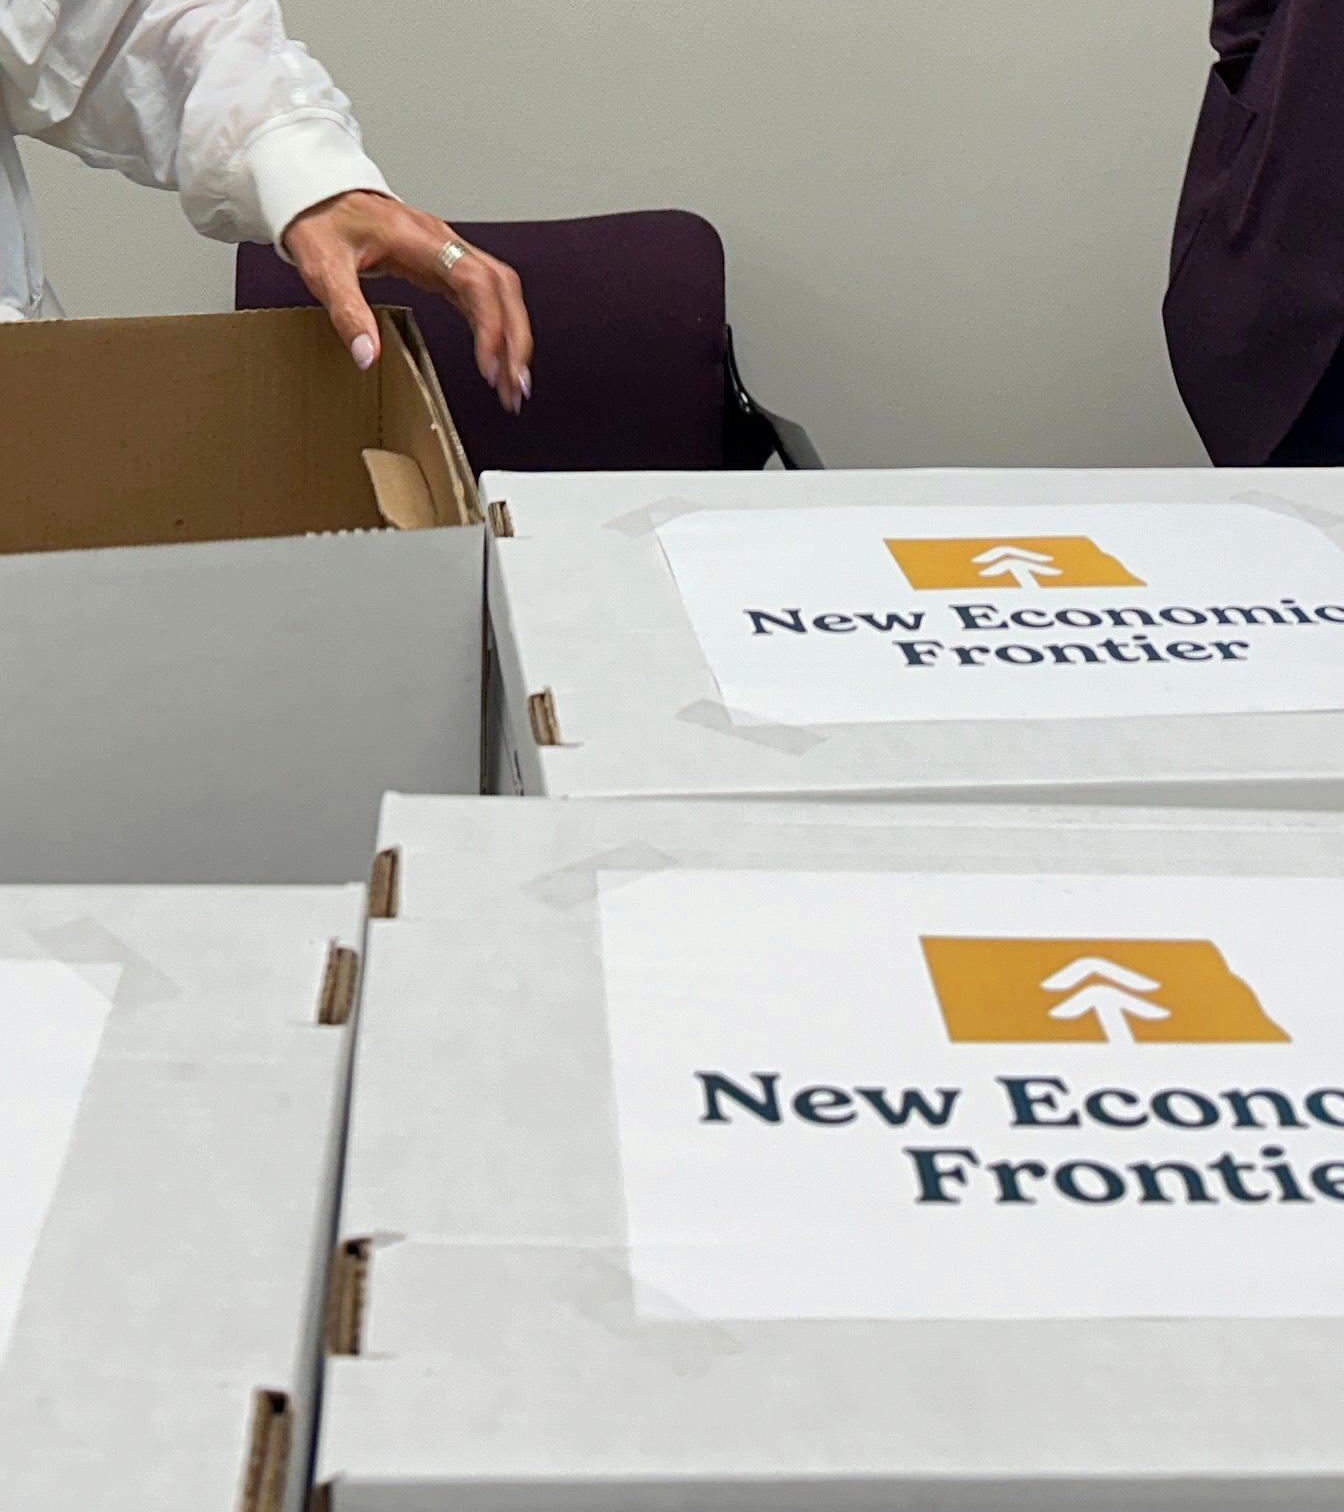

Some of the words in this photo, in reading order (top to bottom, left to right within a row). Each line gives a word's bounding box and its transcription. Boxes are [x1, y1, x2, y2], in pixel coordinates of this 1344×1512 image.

[745, 607, 925, 635] New
[894, 634, 1250, 668] Frontier
[695, 1072, 960, 1128] New
